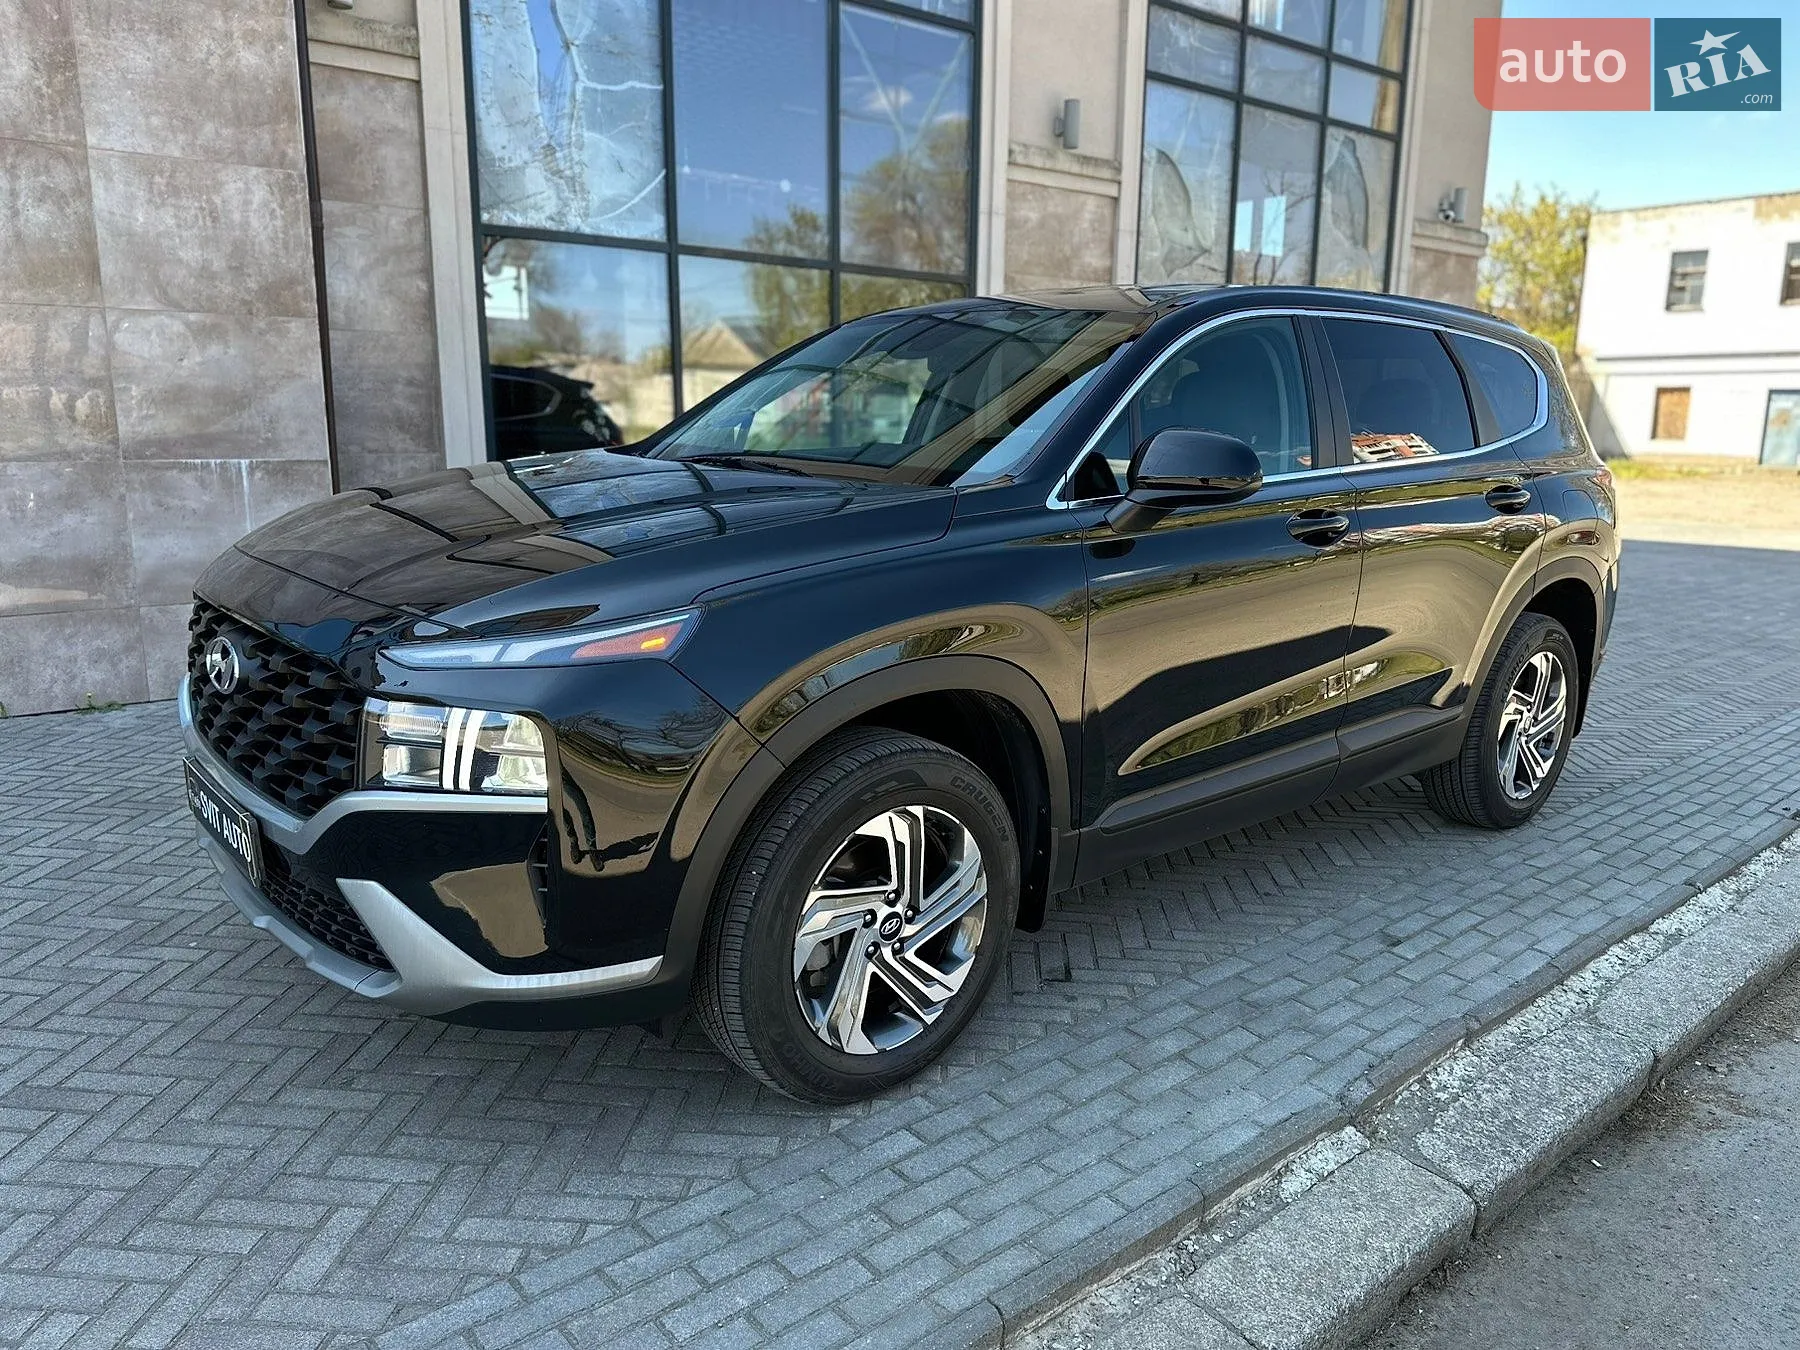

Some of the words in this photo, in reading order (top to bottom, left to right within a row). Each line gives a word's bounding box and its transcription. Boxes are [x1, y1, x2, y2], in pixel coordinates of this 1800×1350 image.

[200, 790, 220, 832] SVIT
[222, 813, 251, 862] AUTO
[950, 775, 1009, 842] CRUGEN
